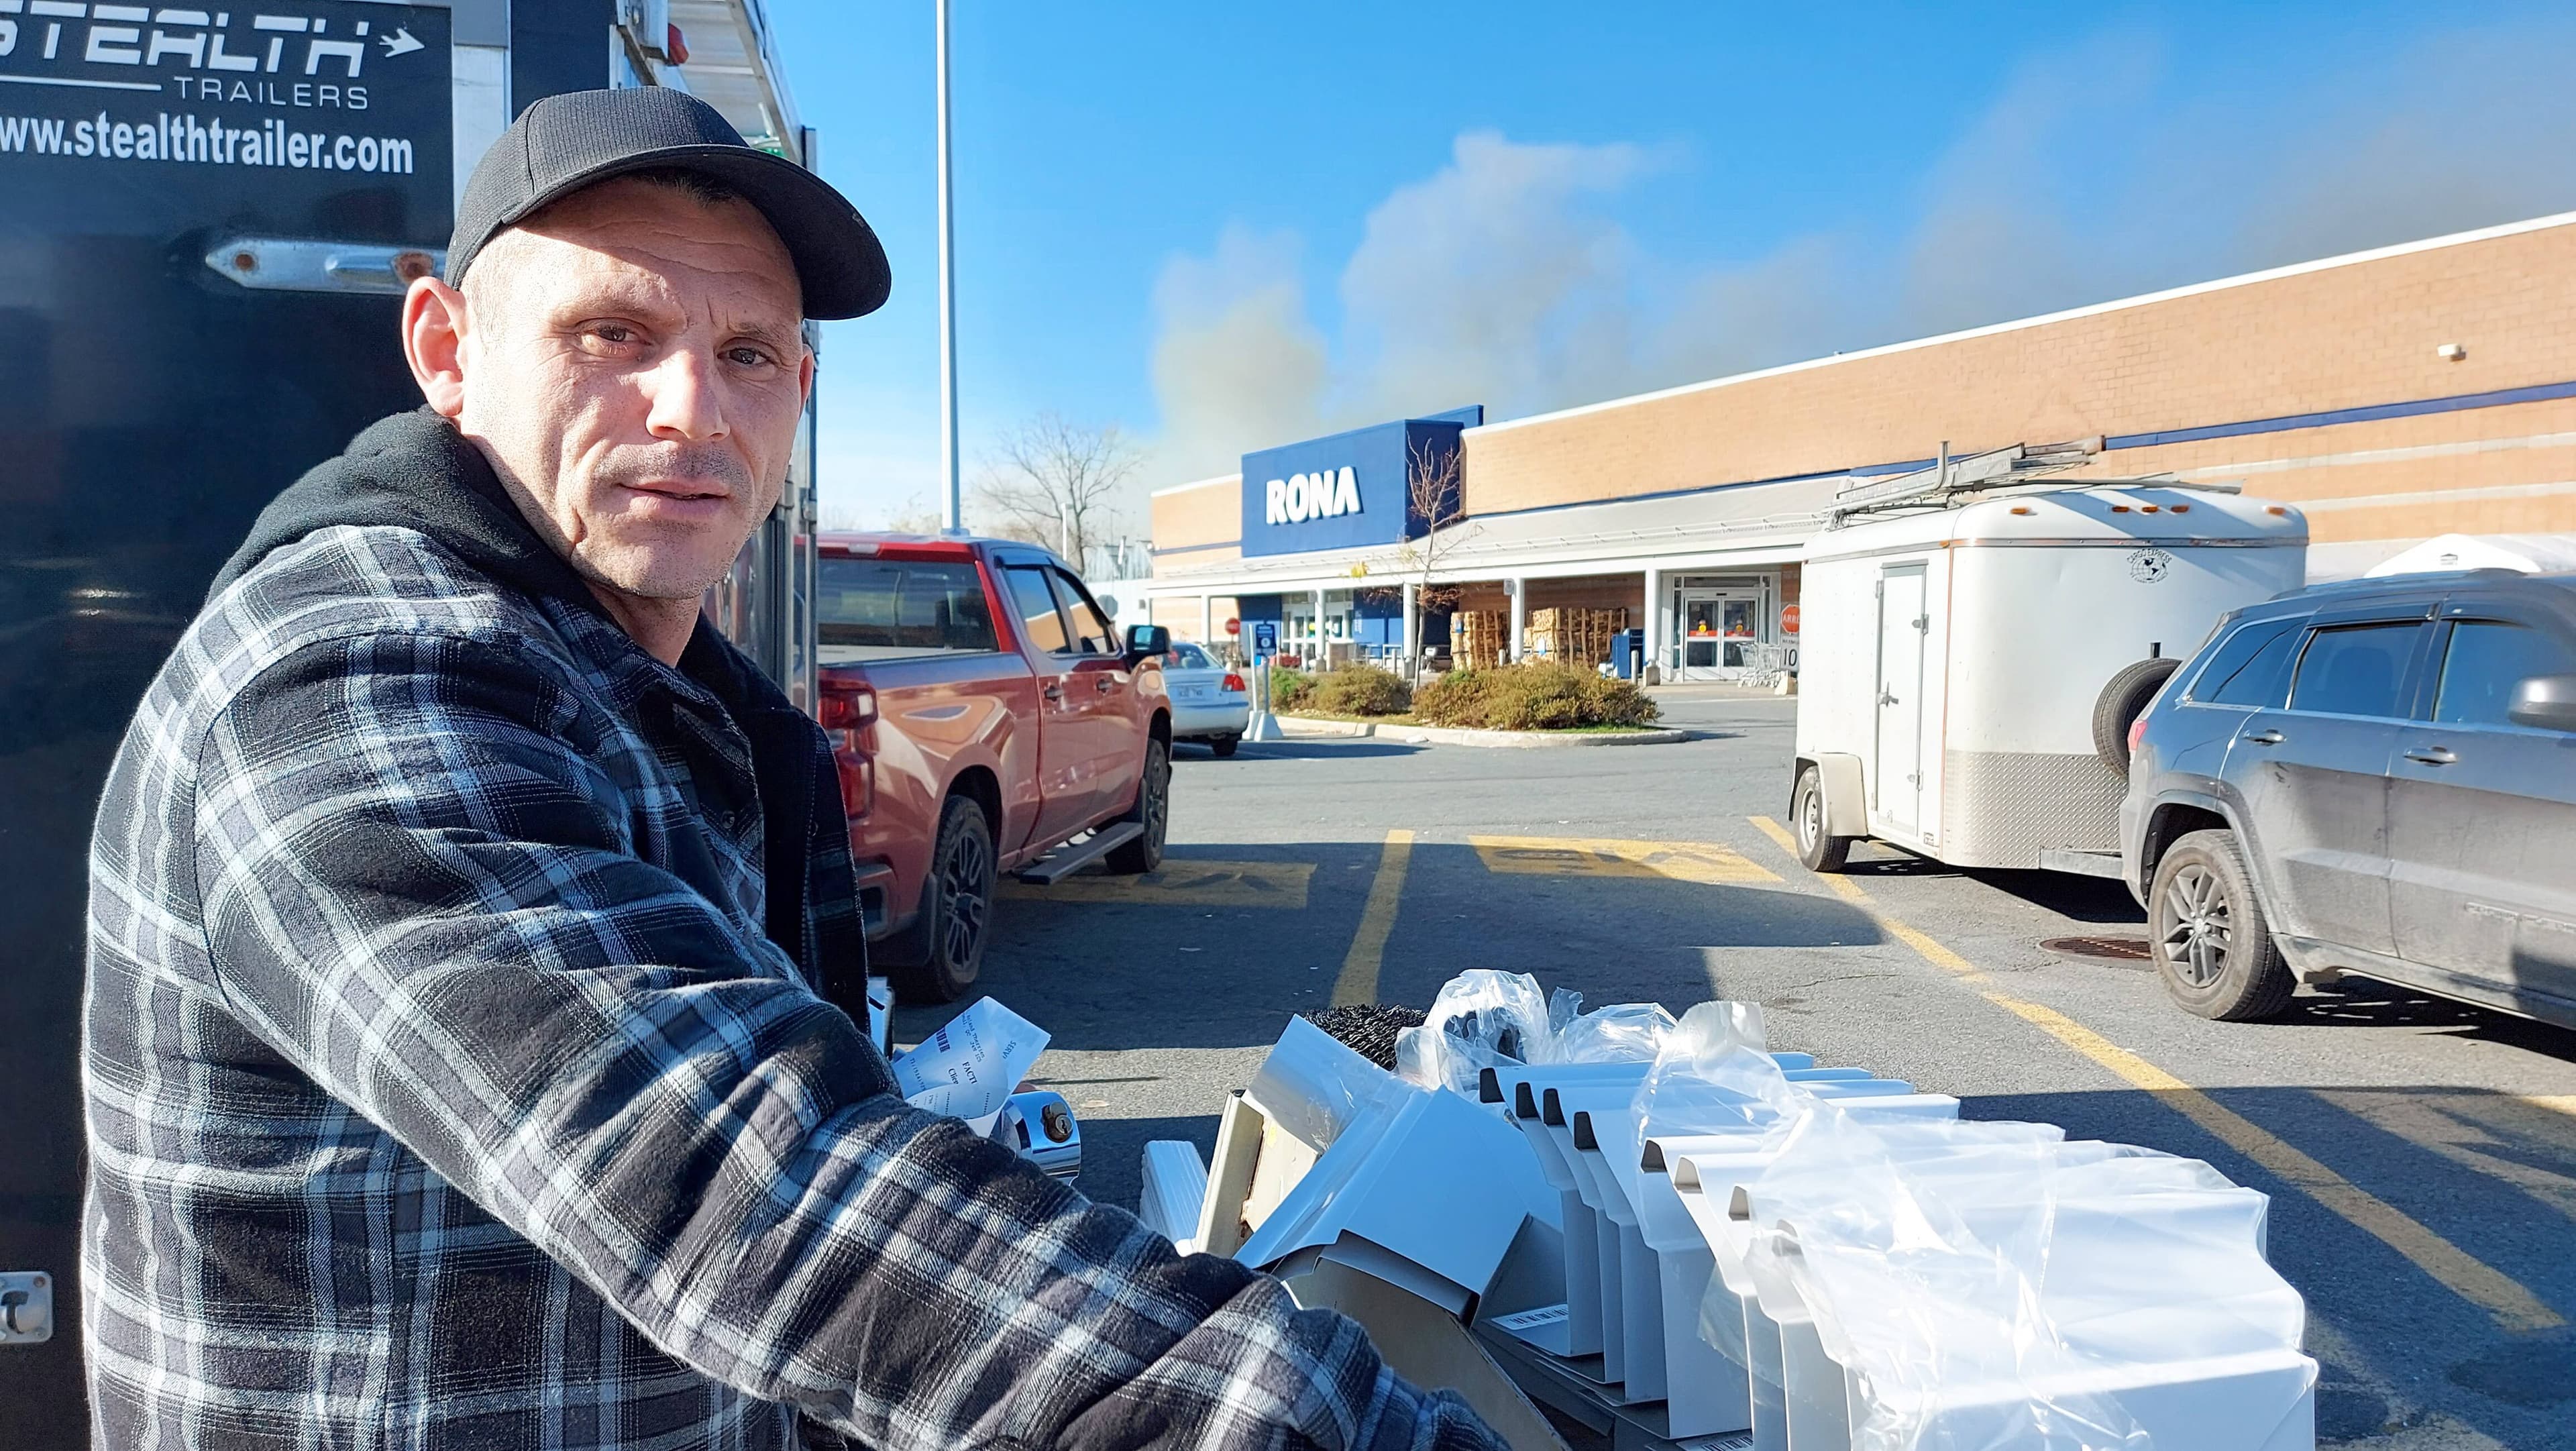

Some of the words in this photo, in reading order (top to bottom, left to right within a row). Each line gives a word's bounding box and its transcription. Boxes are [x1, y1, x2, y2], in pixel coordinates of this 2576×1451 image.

[173, 76, 368, 111] TRAILERS
[1265, 466, 1364, 526] RONA
[2147, 547, 2172, 563] EXPRESS
[1784, 648, 1797, 666] 10
